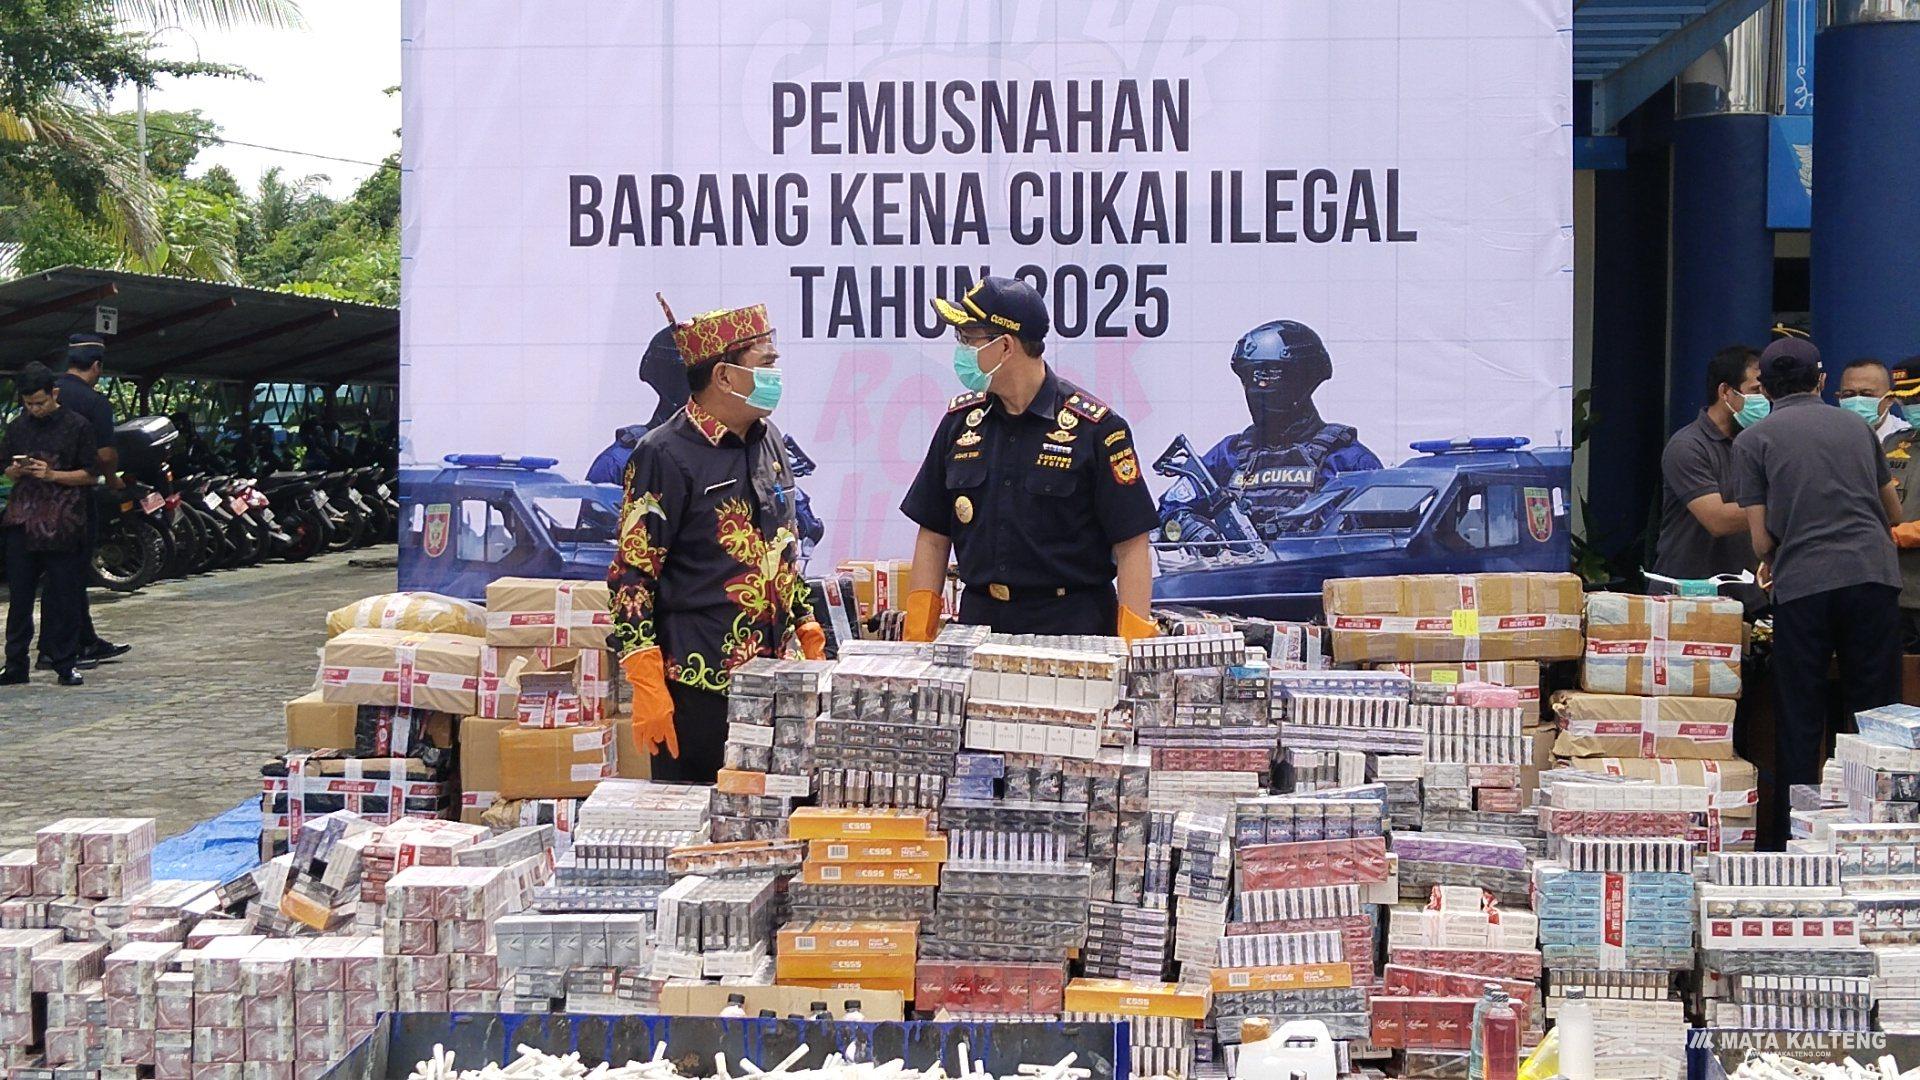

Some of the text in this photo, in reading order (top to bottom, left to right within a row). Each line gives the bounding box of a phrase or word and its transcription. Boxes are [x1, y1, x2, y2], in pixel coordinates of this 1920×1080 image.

[772, 79, 1189, 155] PEMUSNAHAN
[569, 168, 1417, 247] BARANG KENA CUKAI ILEGAL
[1262, 470, 1312, 484] CUKAI
